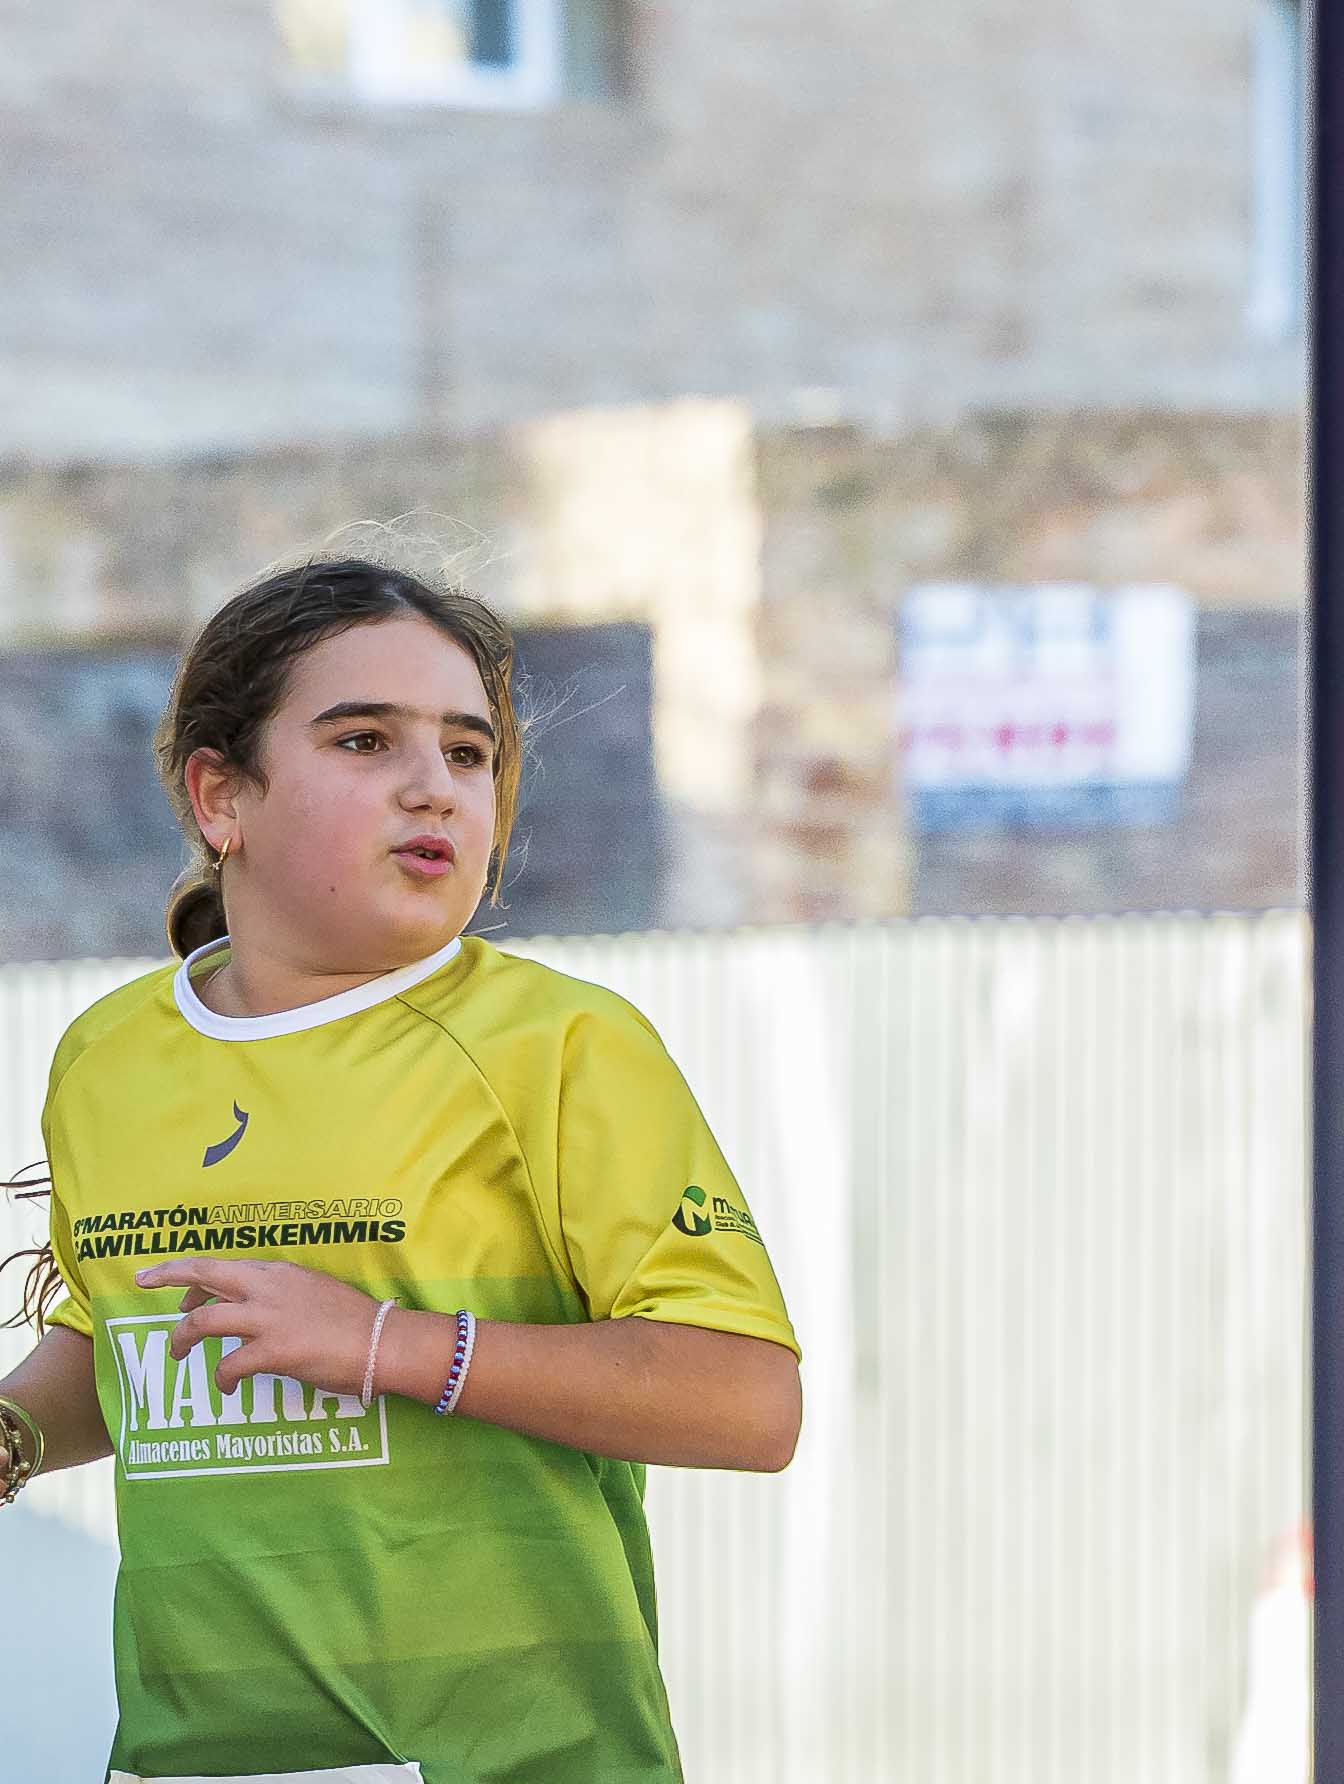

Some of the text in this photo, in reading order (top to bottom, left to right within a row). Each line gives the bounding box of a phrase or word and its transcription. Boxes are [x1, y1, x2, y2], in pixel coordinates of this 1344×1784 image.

[117, 1330, 367, 1432] MAI
[128, 1426, 369, 1465] Almacenes Mayoristas S.A.
